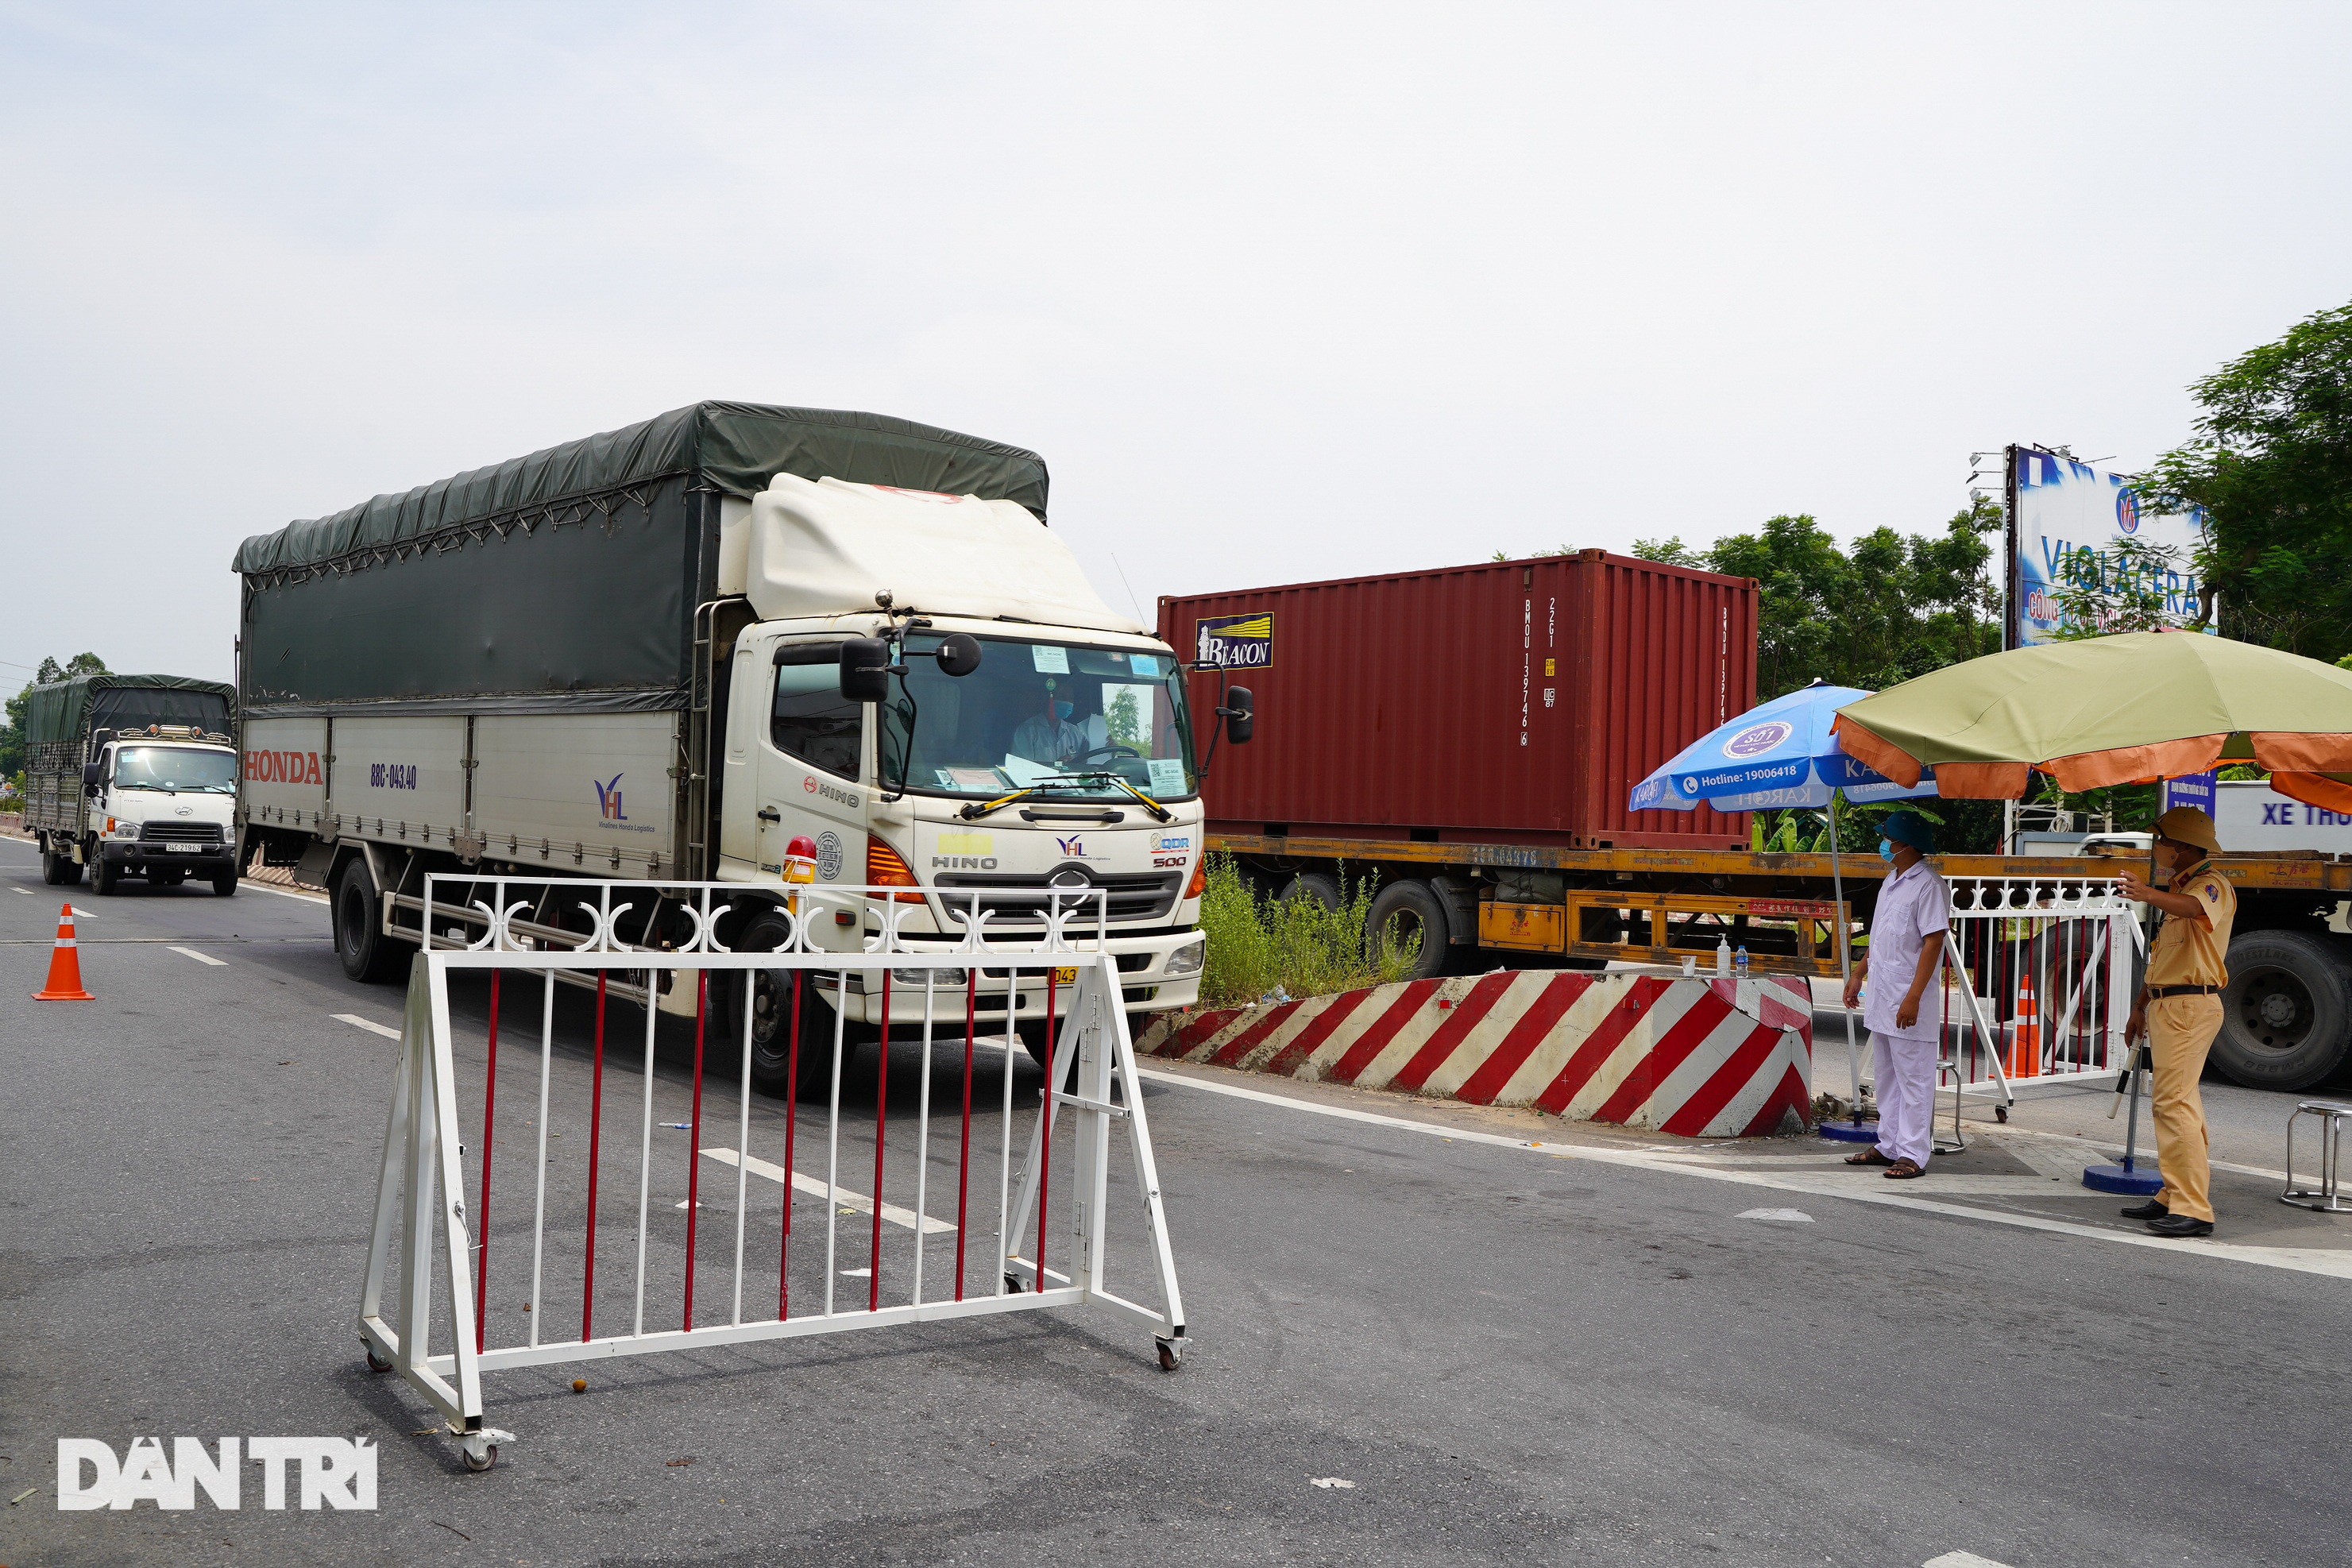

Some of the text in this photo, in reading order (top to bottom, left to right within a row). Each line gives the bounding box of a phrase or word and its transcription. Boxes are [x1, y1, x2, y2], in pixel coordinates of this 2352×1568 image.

[2028, 587, 2058, 622] CÔNG
[1208, 638, 1269, 666] BEACON
[244, 749, 323, 786] HONDA
[371, 763, 417, 790] 88C-043.40
[1701, 765, 1797, 787] Hotline: 19006418
[819, 783, 859, 808] HINO
[2261, 803, 2293, 825] XE
[1161, 838, 1189, 849] QDR
[933, 855, 998, 870] HINO
[1153, 856, 1186, 867] 500
